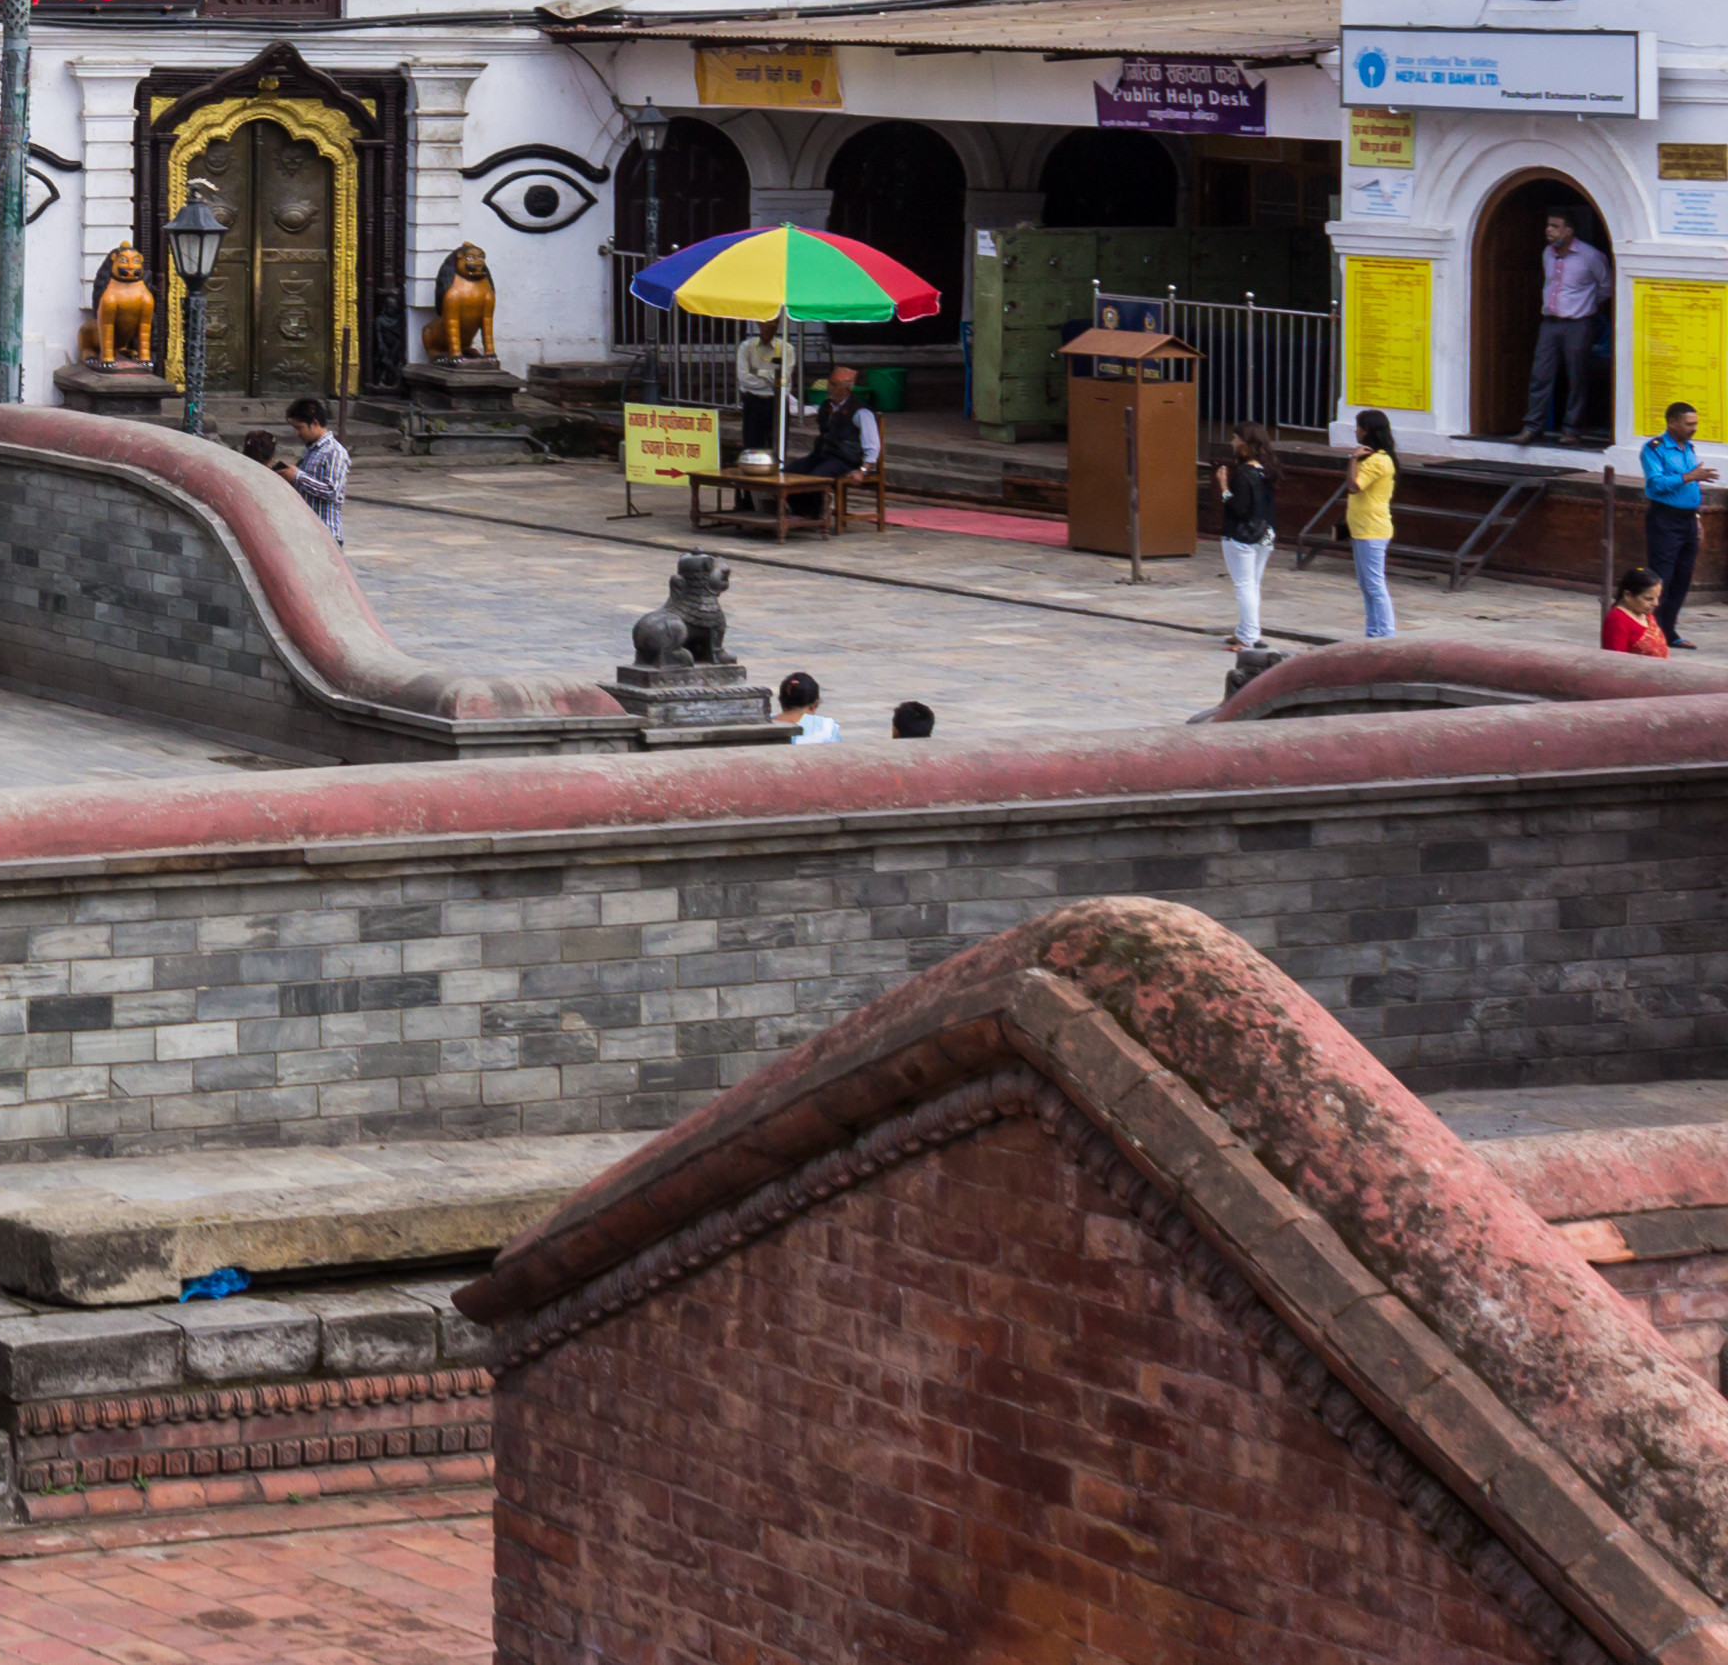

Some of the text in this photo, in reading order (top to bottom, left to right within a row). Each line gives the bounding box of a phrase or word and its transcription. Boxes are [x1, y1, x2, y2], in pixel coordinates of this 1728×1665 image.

[1395, 70, 1428, 83] NEPAL
[1431, 71, 1445, 83] SBI
[1448, 72, 1477, 85] BANK
[1112, 85, 1251, 108] Public Help Desk
[1500, 90, 1624, 102] Pashupati Extension Counter
